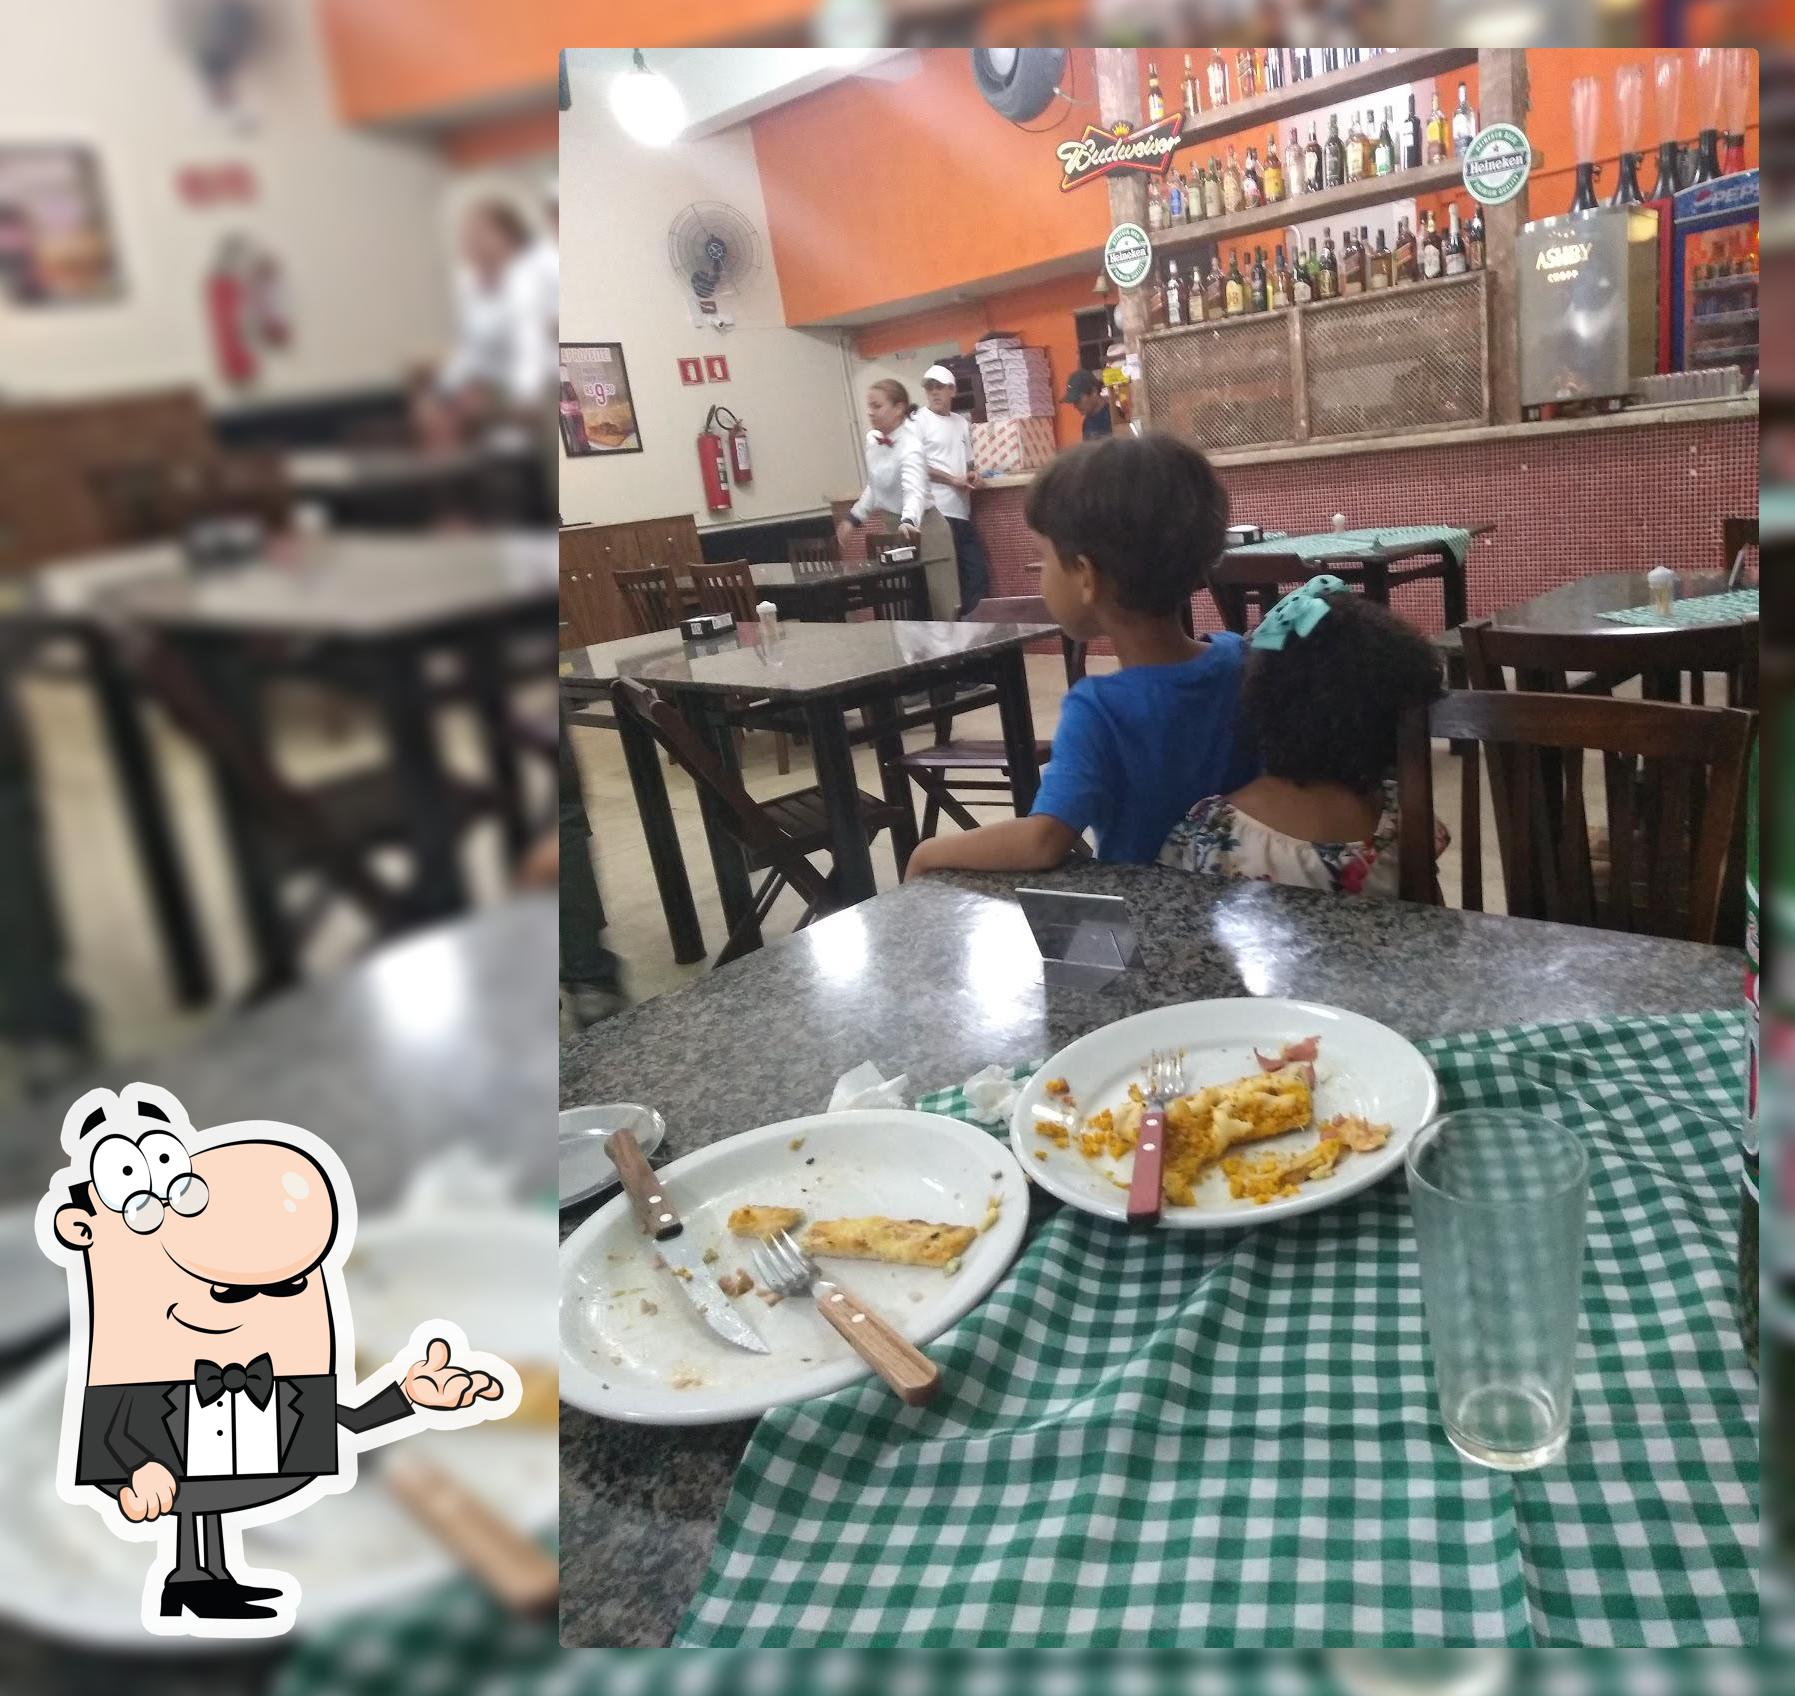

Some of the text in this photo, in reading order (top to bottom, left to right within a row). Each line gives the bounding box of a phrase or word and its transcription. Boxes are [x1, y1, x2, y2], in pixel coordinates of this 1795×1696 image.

[1056, 135, 1182, 175] Budweiser
[1470, 155, 1524, 174] Heineken
[1109, 249, 1147, 264] Heineken
